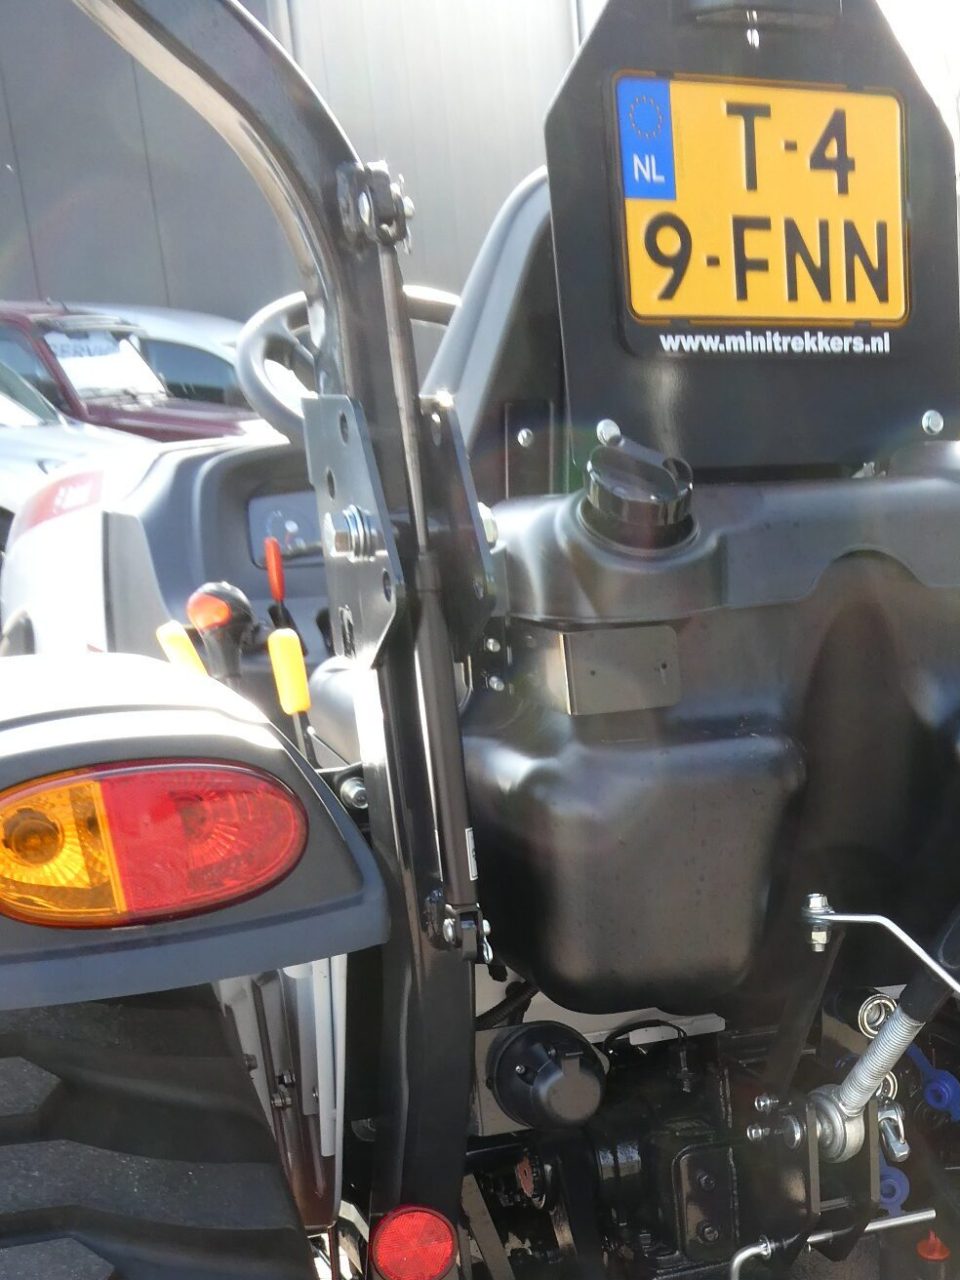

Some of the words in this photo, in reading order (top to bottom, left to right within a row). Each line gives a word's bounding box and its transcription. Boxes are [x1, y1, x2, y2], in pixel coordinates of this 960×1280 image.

[632, 153, 665, 183] NL
[725, 102, 855, 195] T-4
[644, 211, 889, 304] 9-FNN
[660, 331, 890, 353] www.minitrekkers.nl
